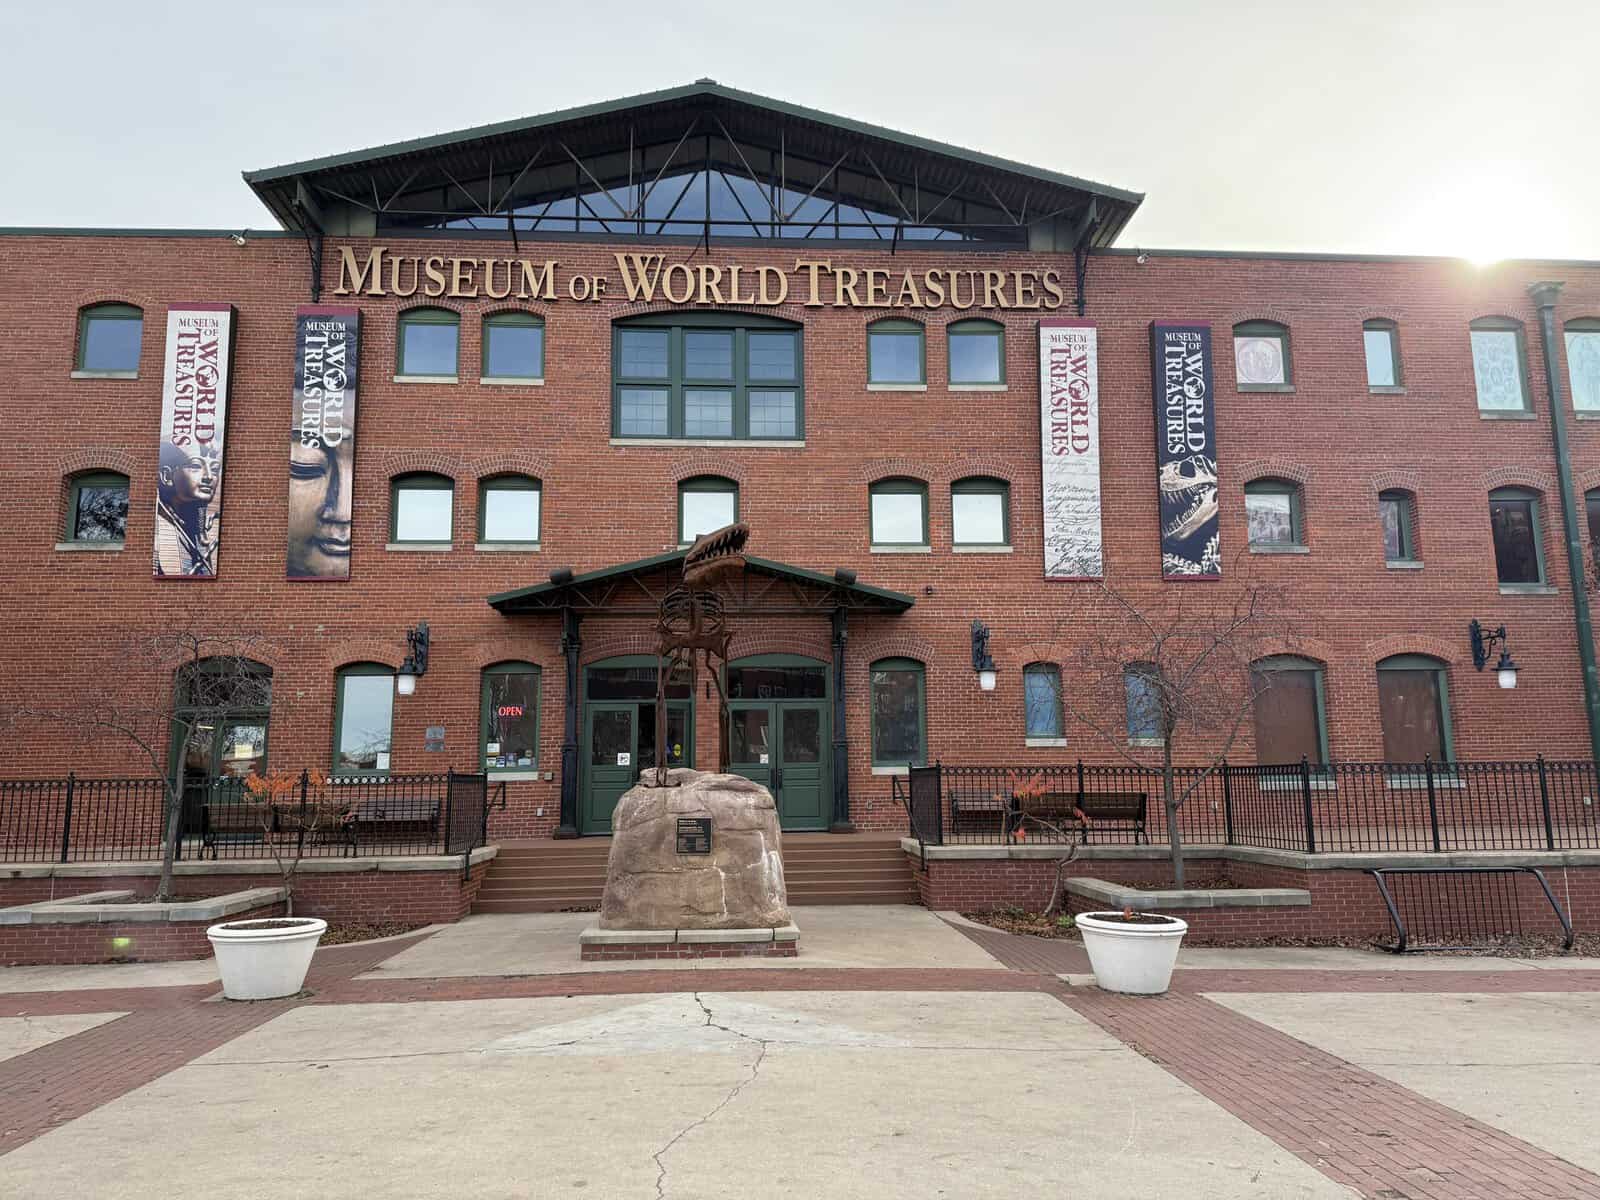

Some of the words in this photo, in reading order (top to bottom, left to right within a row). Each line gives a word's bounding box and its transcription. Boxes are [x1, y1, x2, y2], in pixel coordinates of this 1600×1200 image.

[333, 246, 560, 300] MUSEUM
[568, 275, 607, 301] OF
[614, 252, 789, 306] WORLD
[794, 258, 1065, 309] TREASURES
[178, 318, 219, 328] MUSEUM
[203, 328, 218, 337] OF
[305, 321, 346, 332] MUSEUM
[330, 333, 345, 341] OF
[1050, 334, 1087, 343] MUSEUM
[1165, 332, 1201, 342] MUSEUM
[1188, 342, 1202, 350] OF
[171, 328, 201, 447] TREASURES
[194, 337, 220, 445] WORLD
[301, 331, 329, 449] TREASURES
[322, 341, 348, 448] WORLD
[1049, 343, 1073, 456] TREASURES
[1068, 353, 1090, 454] WORLD
[1164, 342, 1188, 455] TREASURES
[1183, 350, 1206, 453] WORLD
[498, 706, 522, 717] OPEN
